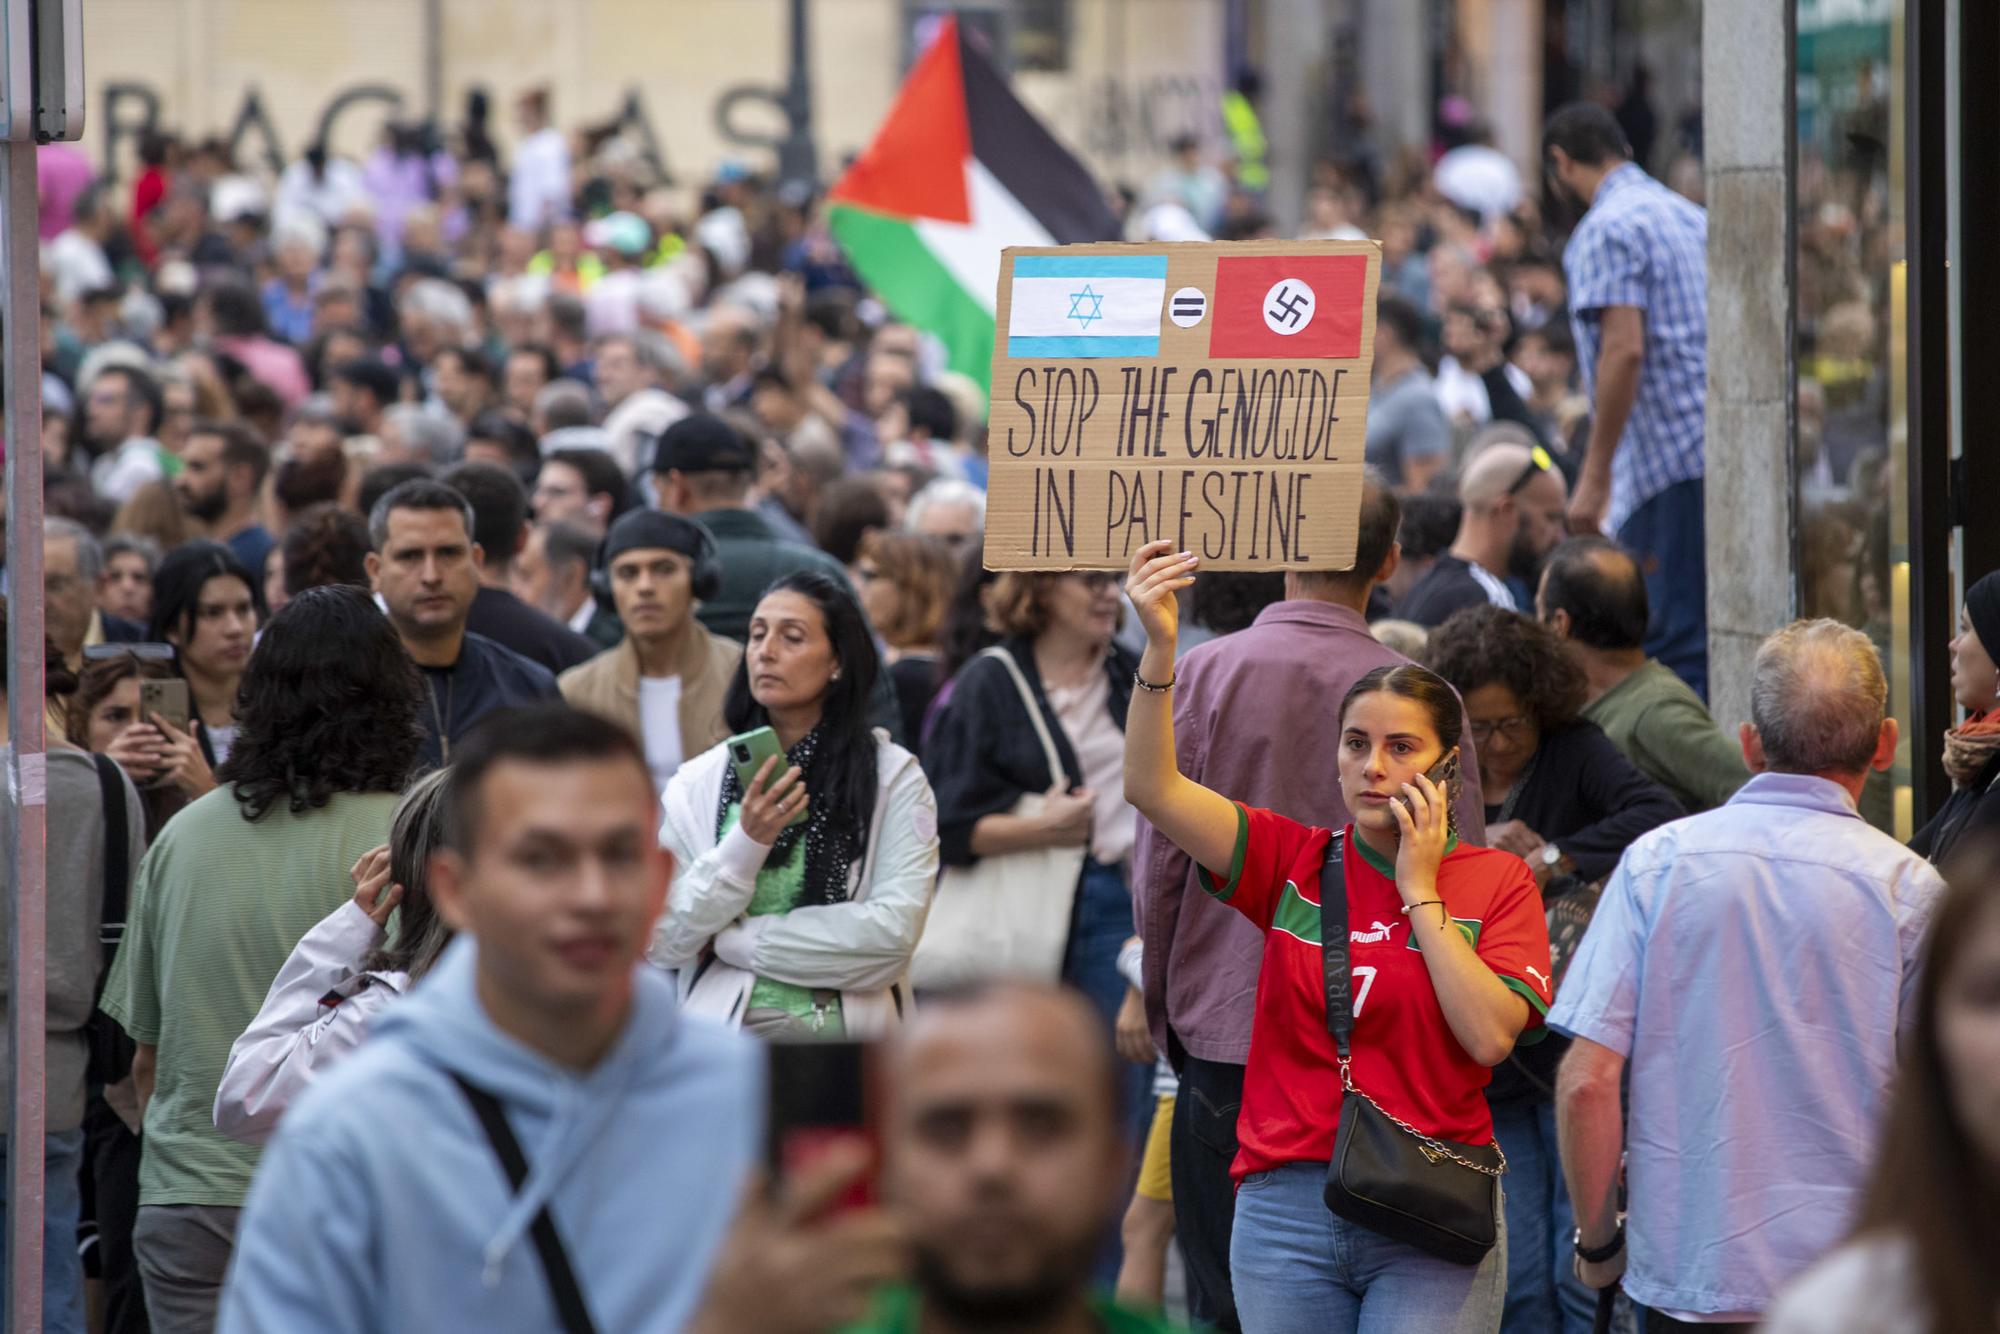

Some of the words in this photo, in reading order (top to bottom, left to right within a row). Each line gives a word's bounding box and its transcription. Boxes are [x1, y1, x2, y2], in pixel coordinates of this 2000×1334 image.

[1007, 366, 1100, 457] STOP
[1116, 366, 1178, 458] THE
[1184, 368, 1348, 460] GENOCIDE
[1032, 467, 1075, 557] IN
[1106, 470, 1312, 562] PALESTINE
[1326, 933, 1350, 1017] PRADA
